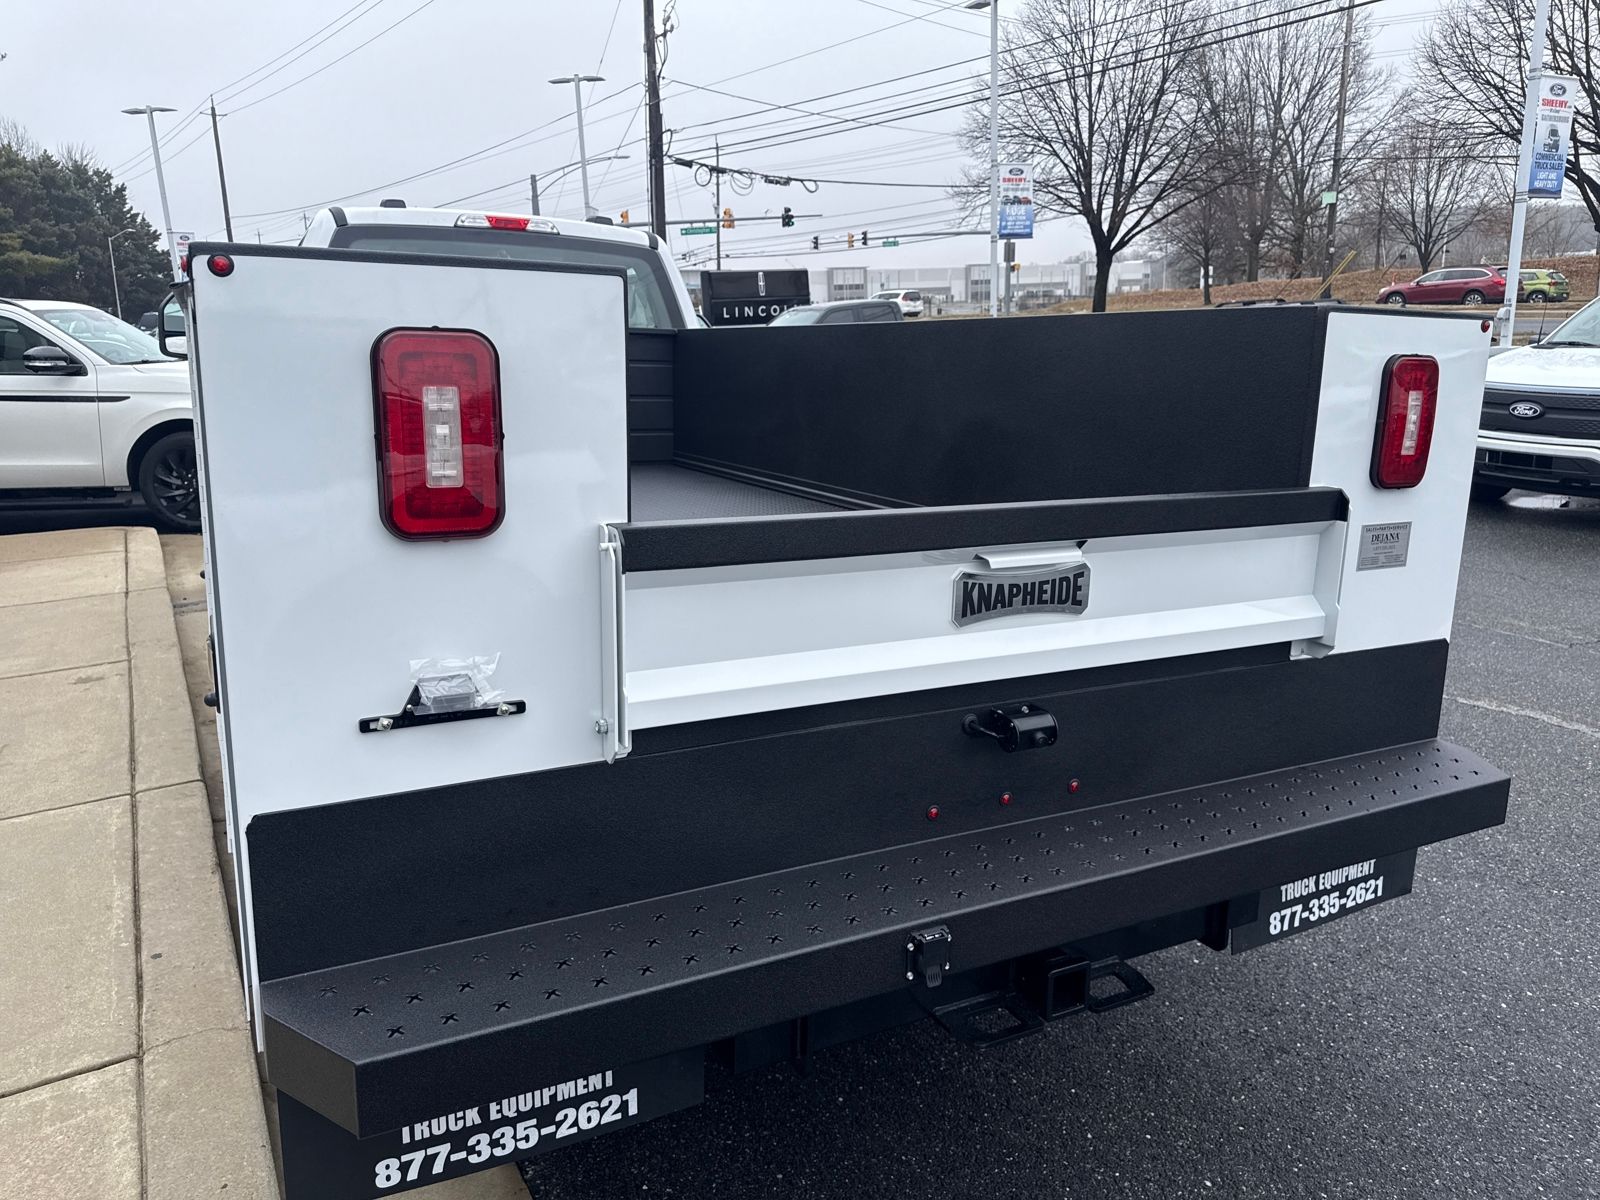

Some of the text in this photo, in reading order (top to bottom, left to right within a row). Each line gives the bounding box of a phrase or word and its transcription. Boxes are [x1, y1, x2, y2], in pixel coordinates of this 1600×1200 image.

[1542, 98, 1569, 109] SHEEHY
[1535, 152, 1564, 162] COMMERCIAL
[1534, 161, 1563, 171] TRUCK SALES
[723, 304, 798, 319] LINCO
[1370, 532, 1400, 543] DEJANA
[960, 571, 1084, 619] KNAPHEIDE
[1280, 858, 1377, 903] TRUCK EQUIPMENT
[1269, 876, 1384, 936] 877-335-2621
[374, 1088, 638, 1188] 877-335-2621
